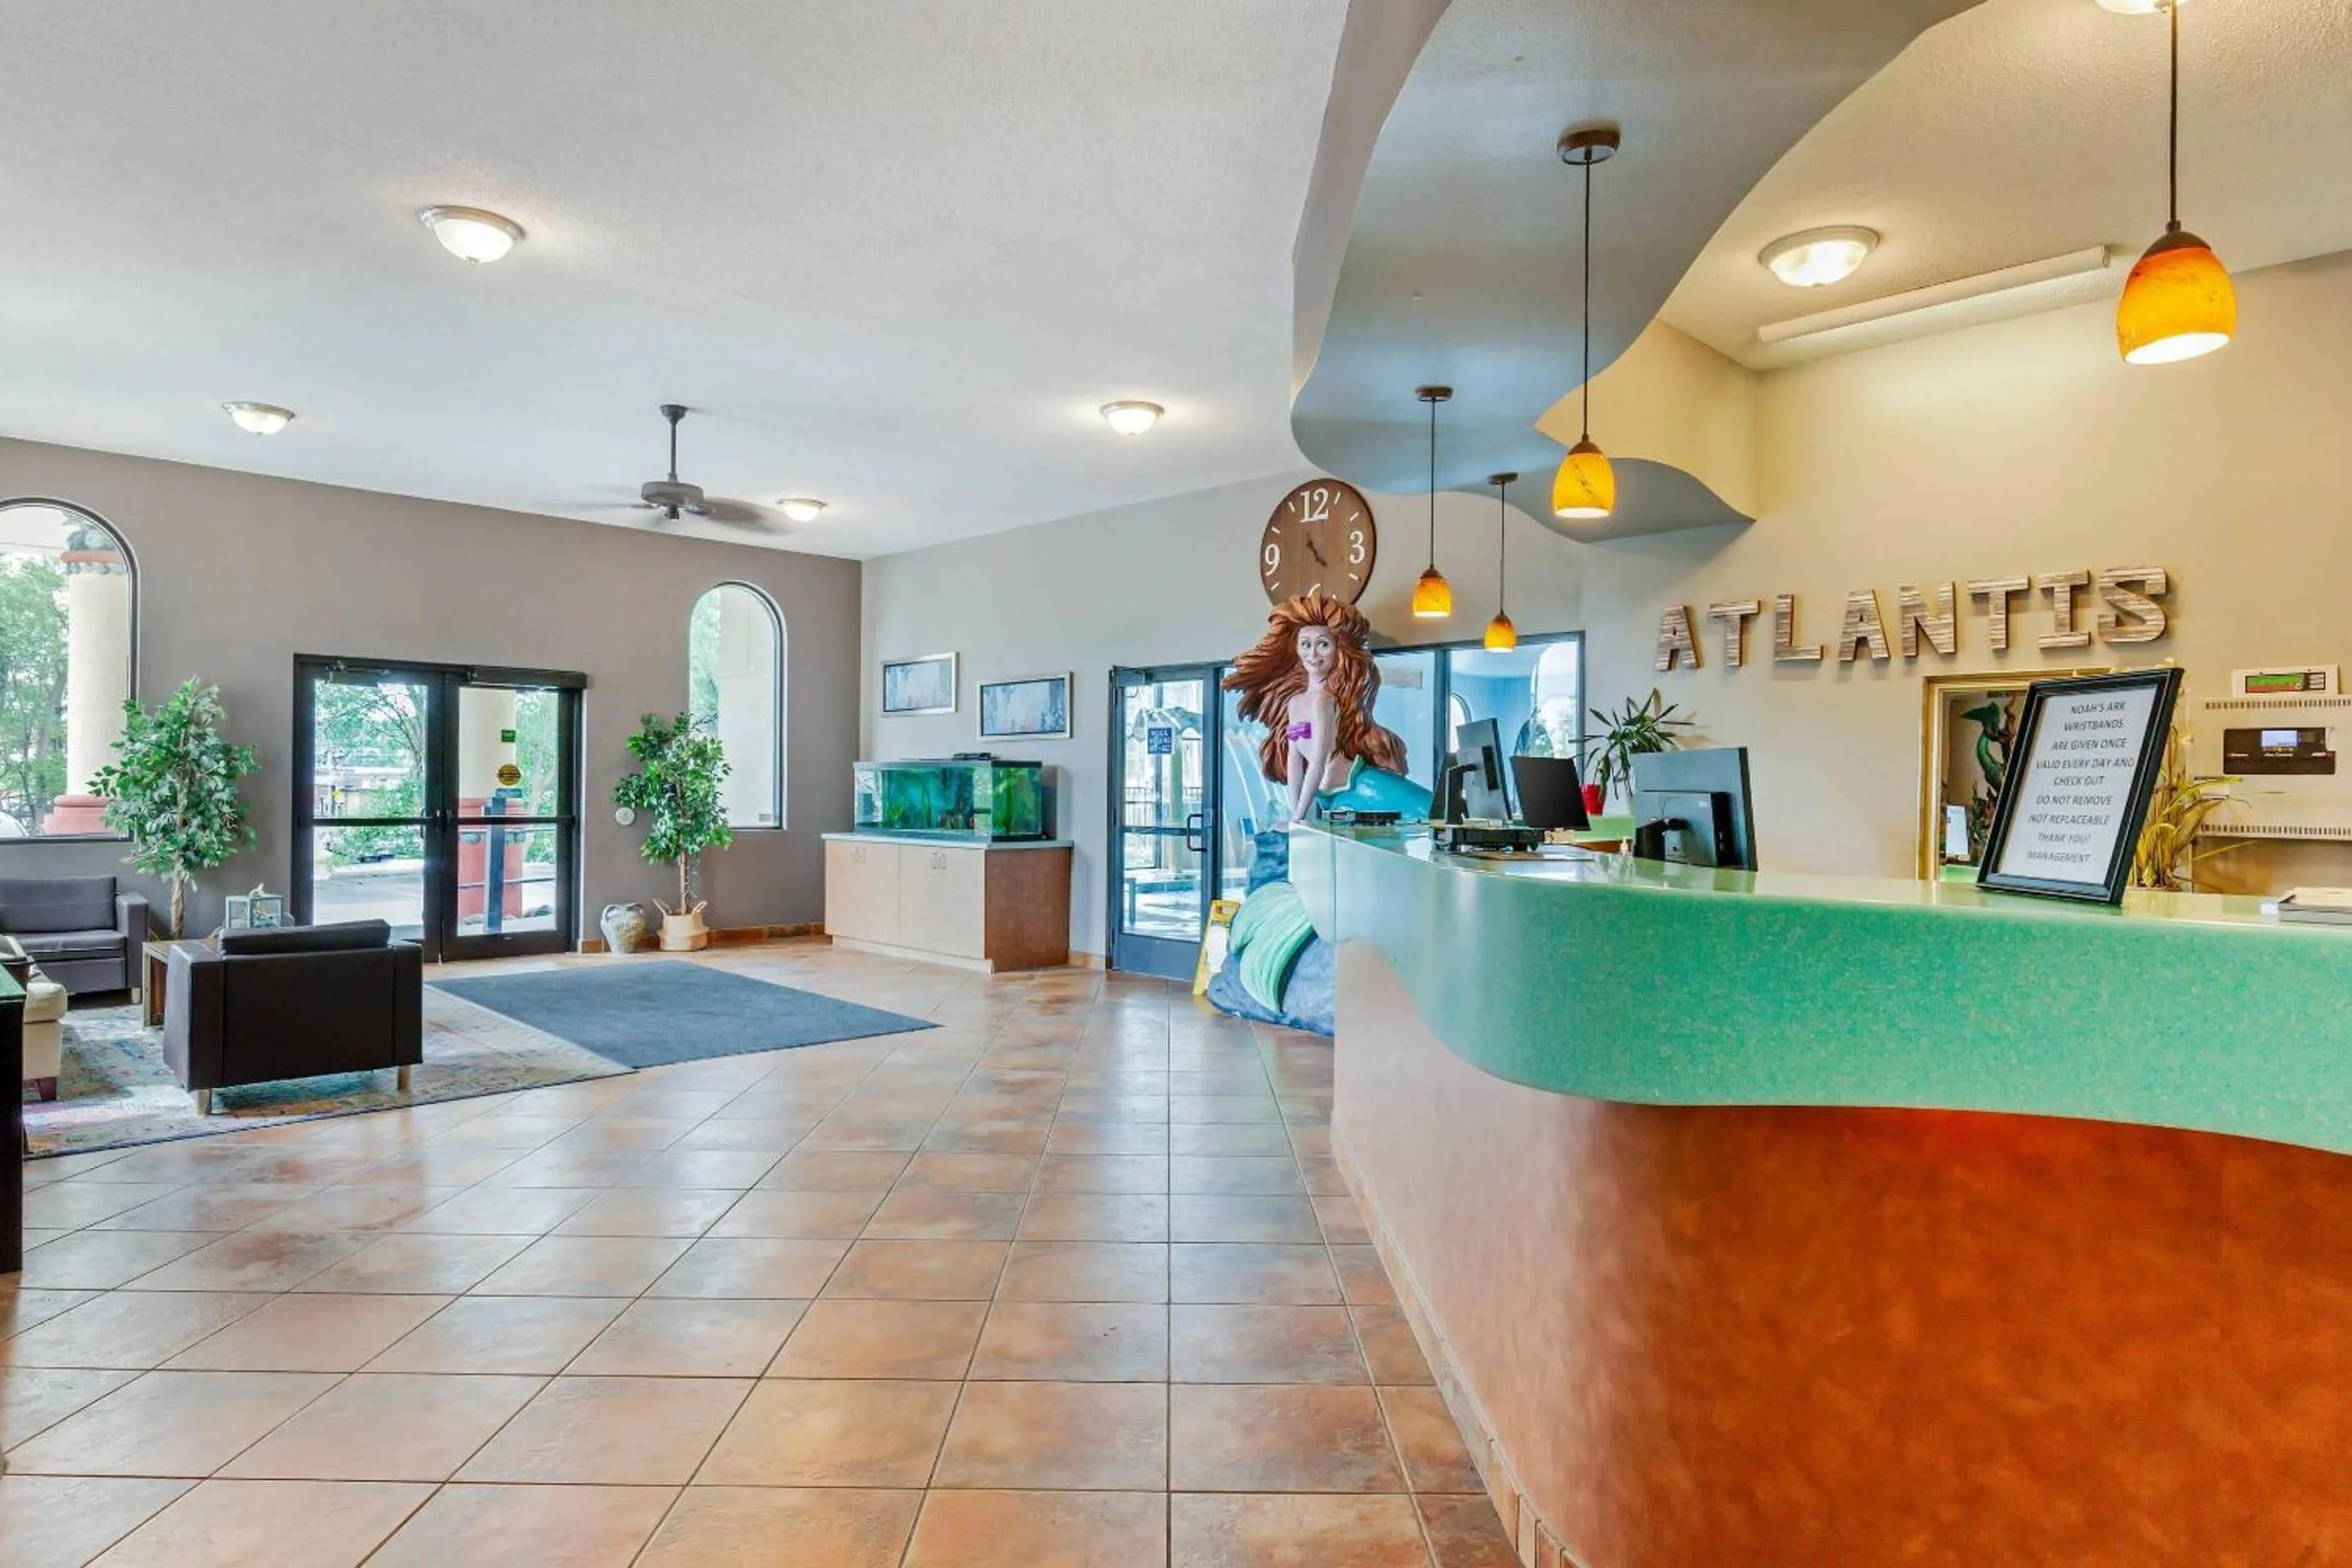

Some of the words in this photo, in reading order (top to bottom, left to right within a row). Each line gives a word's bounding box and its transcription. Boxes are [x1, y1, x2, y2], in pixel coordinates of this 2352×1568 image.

[1300, 488, 1329, 523] 12
[1349, 531, 1365, 564] 3
[1265, 544, 1280, 576] 9
[1655, 565, 2167, 671] ATLANTIS
[2070, 702, 2105, 714] NOAH'S
[2105, 702, 2126, 711] ARK
[2065, 719, 2123, 732] WRISTBANDS
[2051, 741, 2069, 751] ARE
[2070, 739, 2099, 750] GIVEN
[2100, 737, 2127, 749] ONCE
[2036, 760, 2060, 769] VALID
[2062, 759, 2091, 769] EVERY
[2091, 758, 2112, 768] DAY
[2113, 757, 2135, 768] AND
[2053, 776, 2083, 786] CHECK
[2084, 775, 2105, 786] OUT
[2036, 795, 2051, 805] DO
[2051, 795, 2072, 805] NOT
[2073, 795, 2114, 806] REMOVE
[2029, 813, 2047, 824] NOT
[2048, 813, 2110, 825] REPLACEABLE
[2038, 832, 2067, 843] THANK
[2027, 850, 2092, 863] MANAGEMENT
